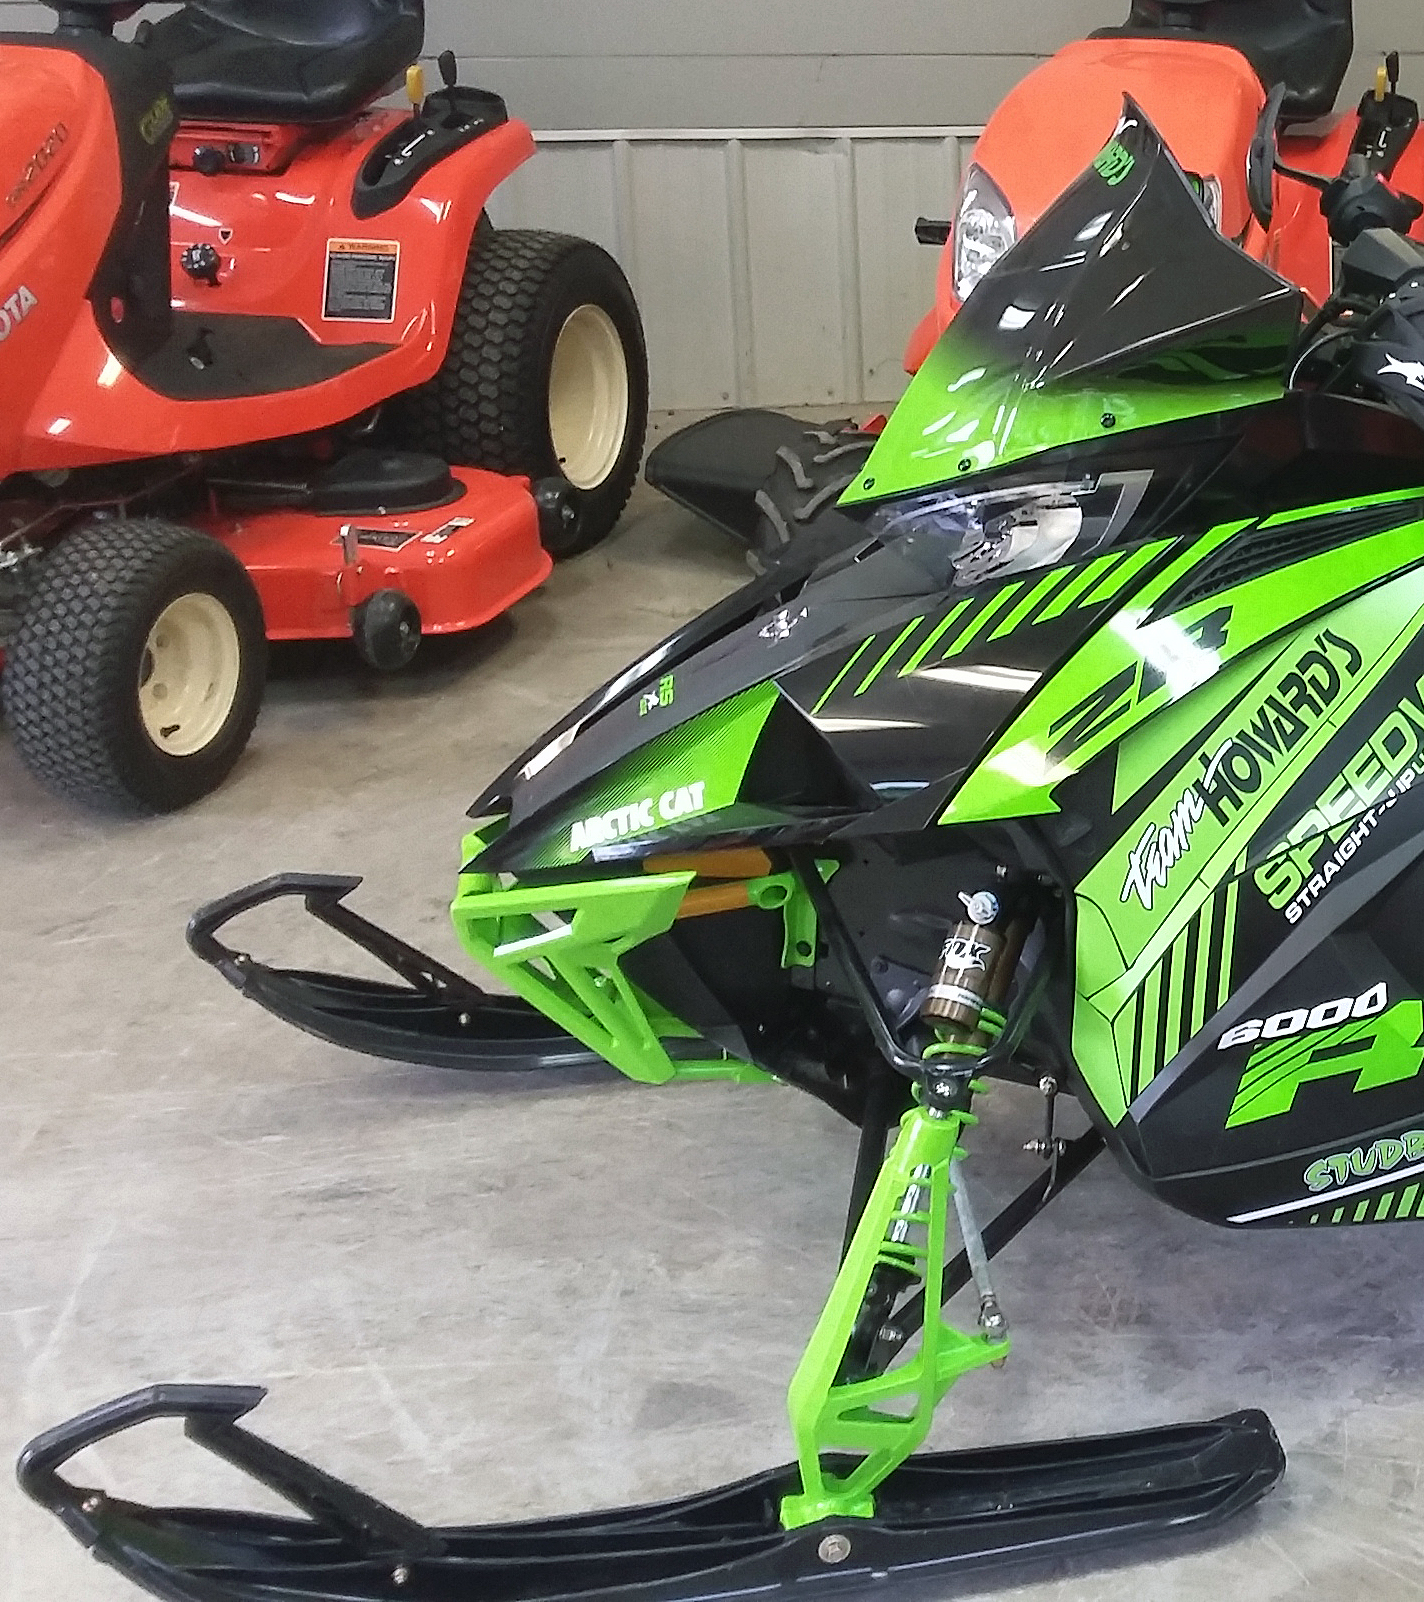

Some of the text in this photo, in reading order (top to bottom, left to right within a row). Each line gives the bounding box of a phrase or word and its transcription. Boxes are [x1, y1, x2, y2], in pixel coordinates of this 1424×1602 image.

[1192, 628, 1363, 828] HOWARD'S
[570, 780, 706, 853] ARCTIC CAT
[1217, 981, 1388, 1051] 6000
